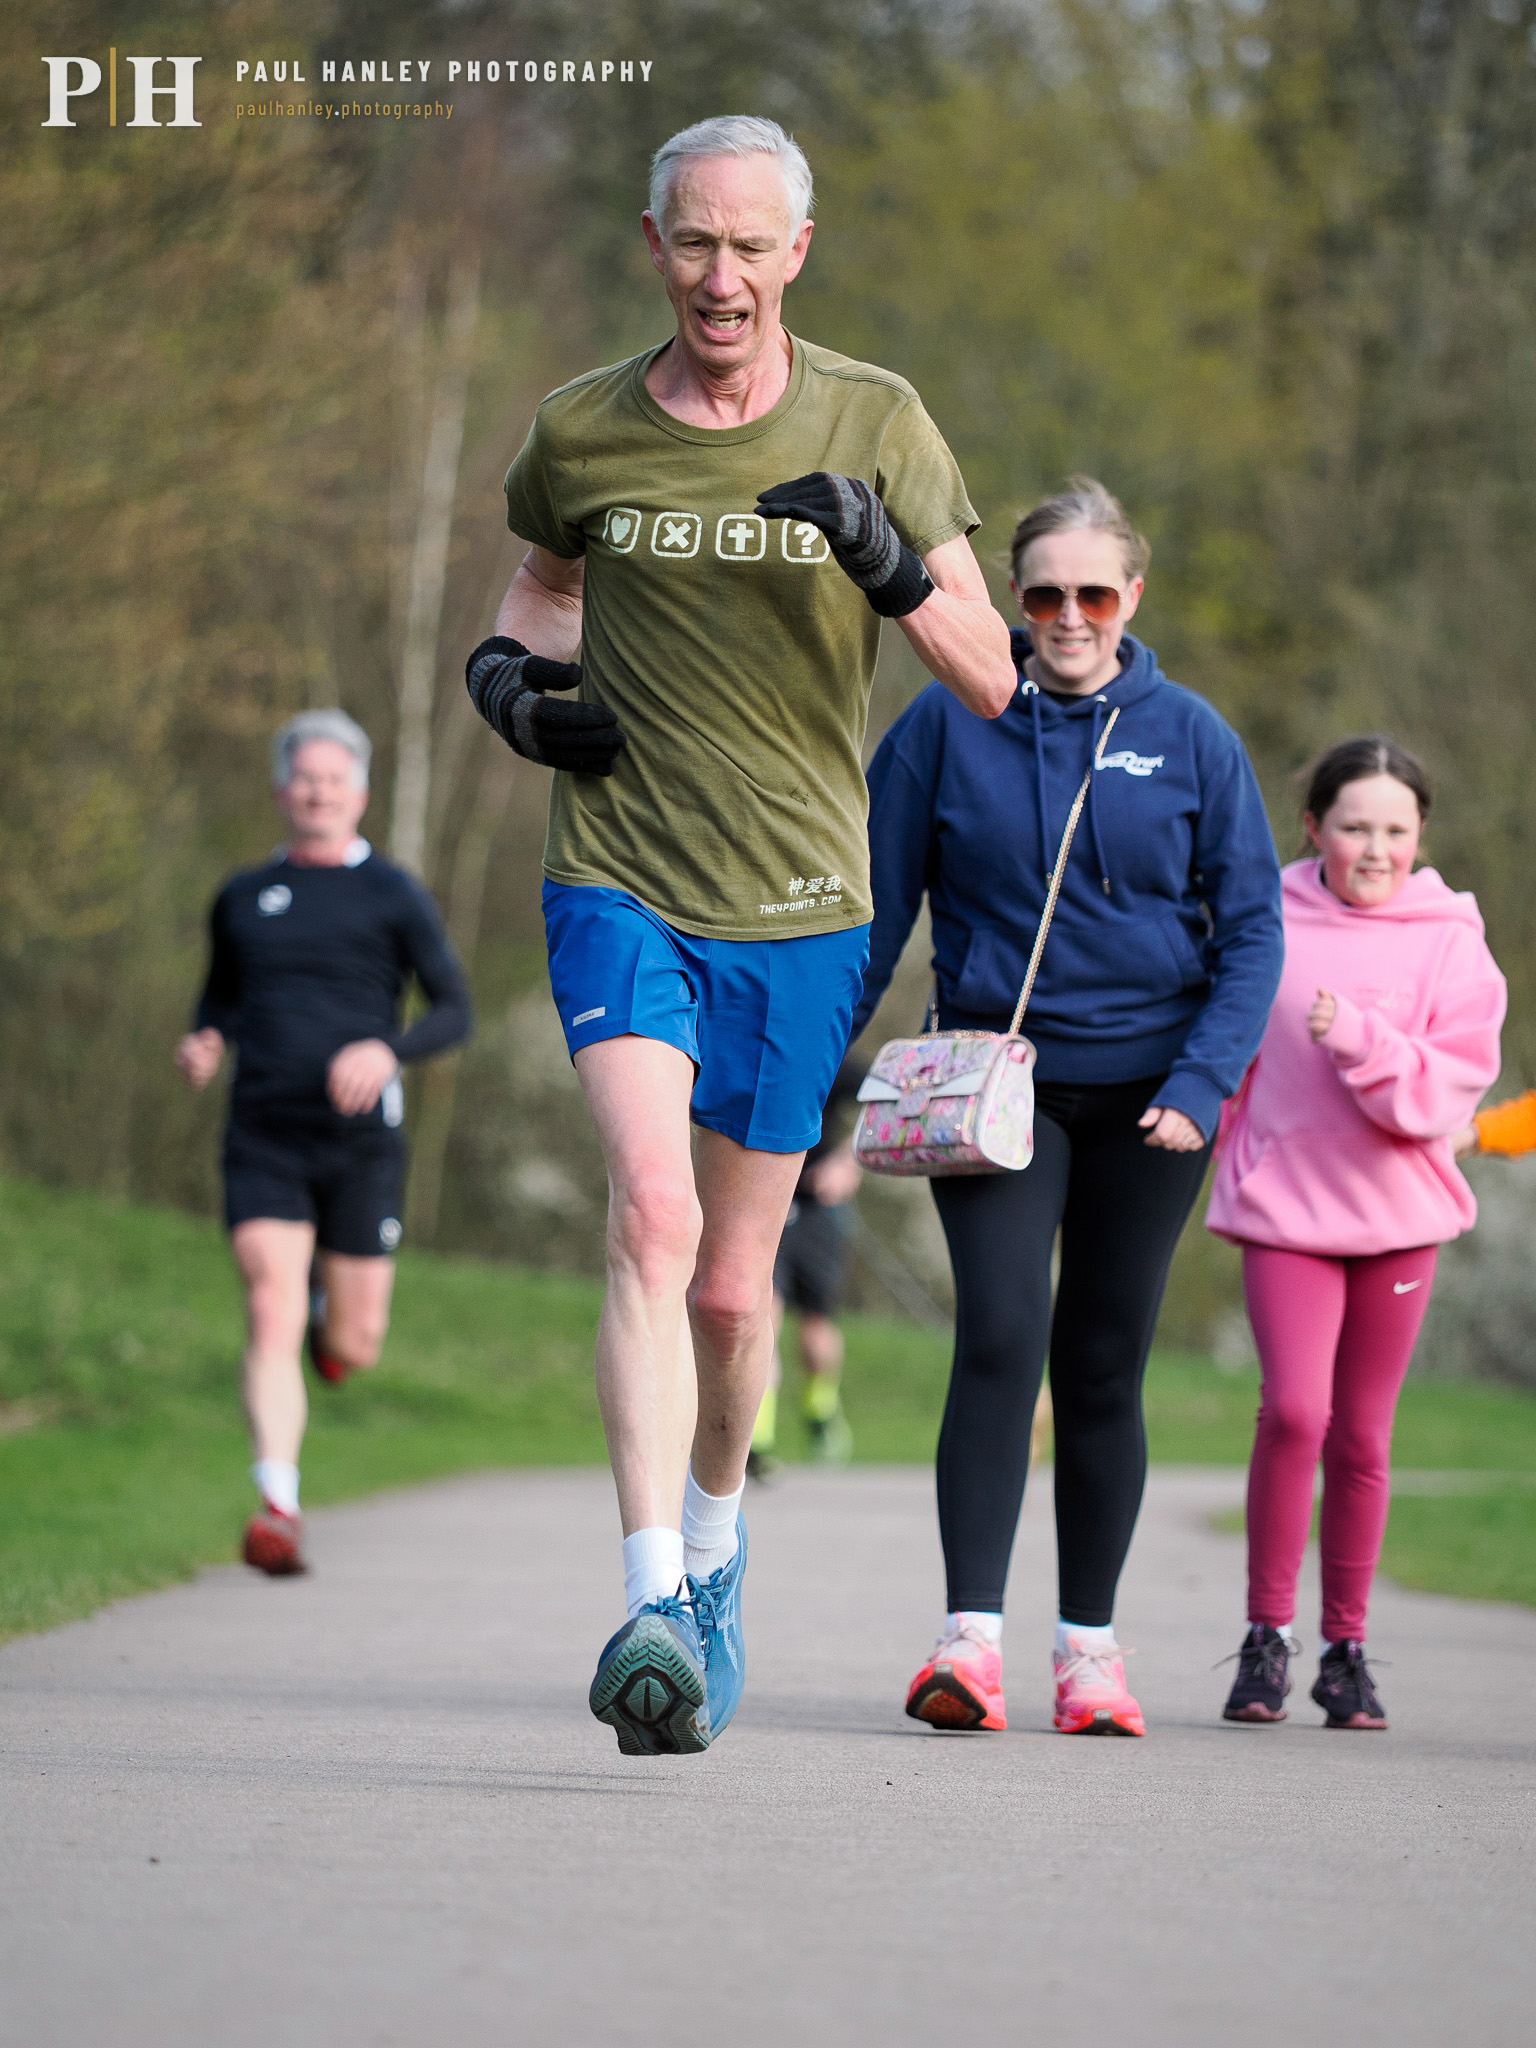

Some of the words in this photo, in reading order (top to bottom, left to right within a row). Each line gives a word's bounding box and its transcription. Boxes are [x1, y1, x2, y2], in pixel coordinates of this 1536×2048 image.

[788, 875, 842, 896] 神爱我
[760, 895, 842, 914] THE4POINTS.COM
